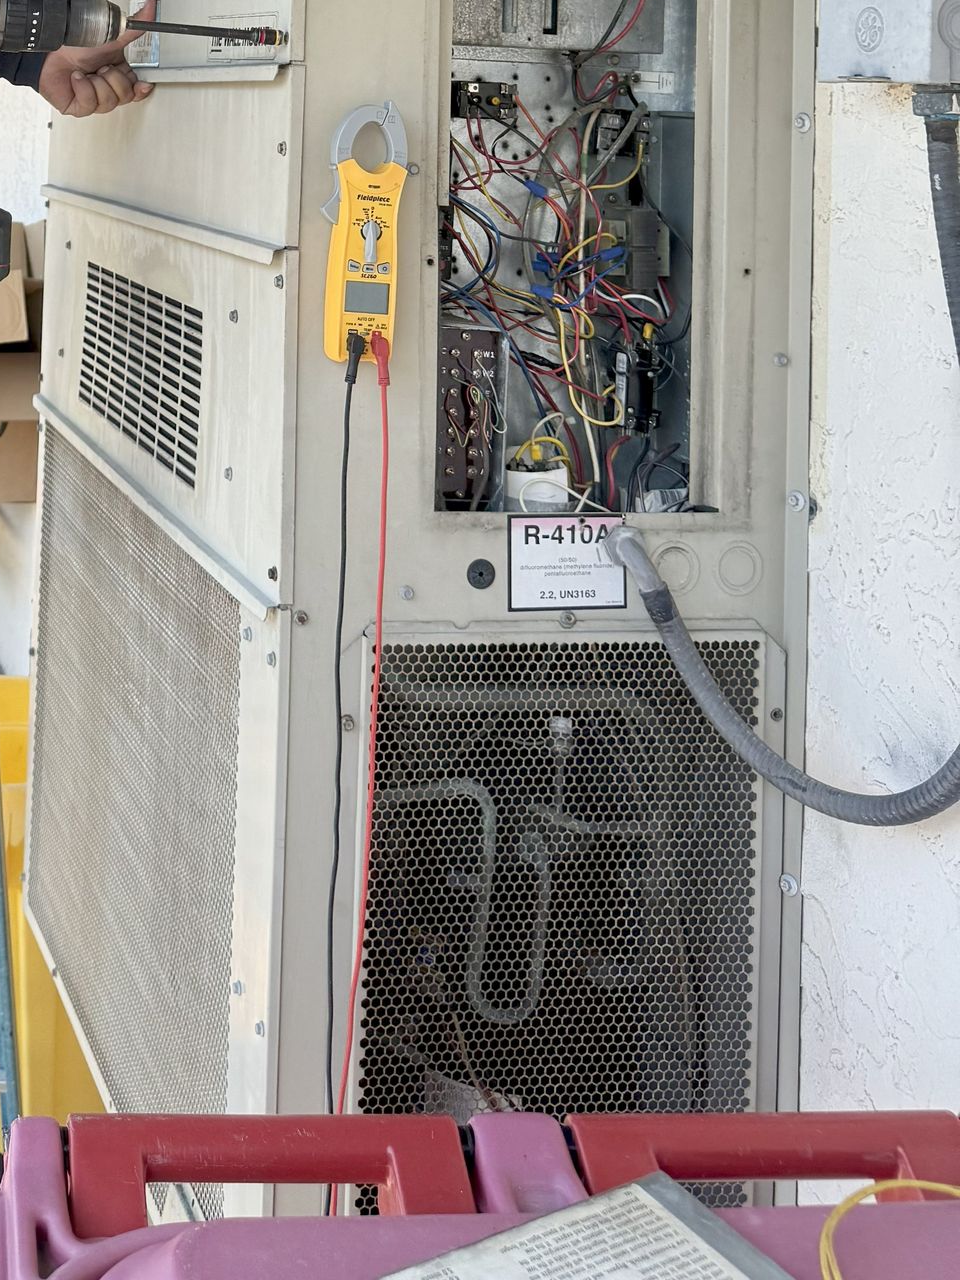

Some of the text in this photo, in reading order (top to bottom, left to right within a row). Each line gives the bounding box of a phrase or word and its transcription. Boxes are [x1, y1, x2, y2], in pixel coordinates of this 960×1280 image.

[357, 194, 390, 203] Fieldpiece
[524, 524, 611, 545] R-410A
[540, 590, 596, 599] 2.2, UN3163
